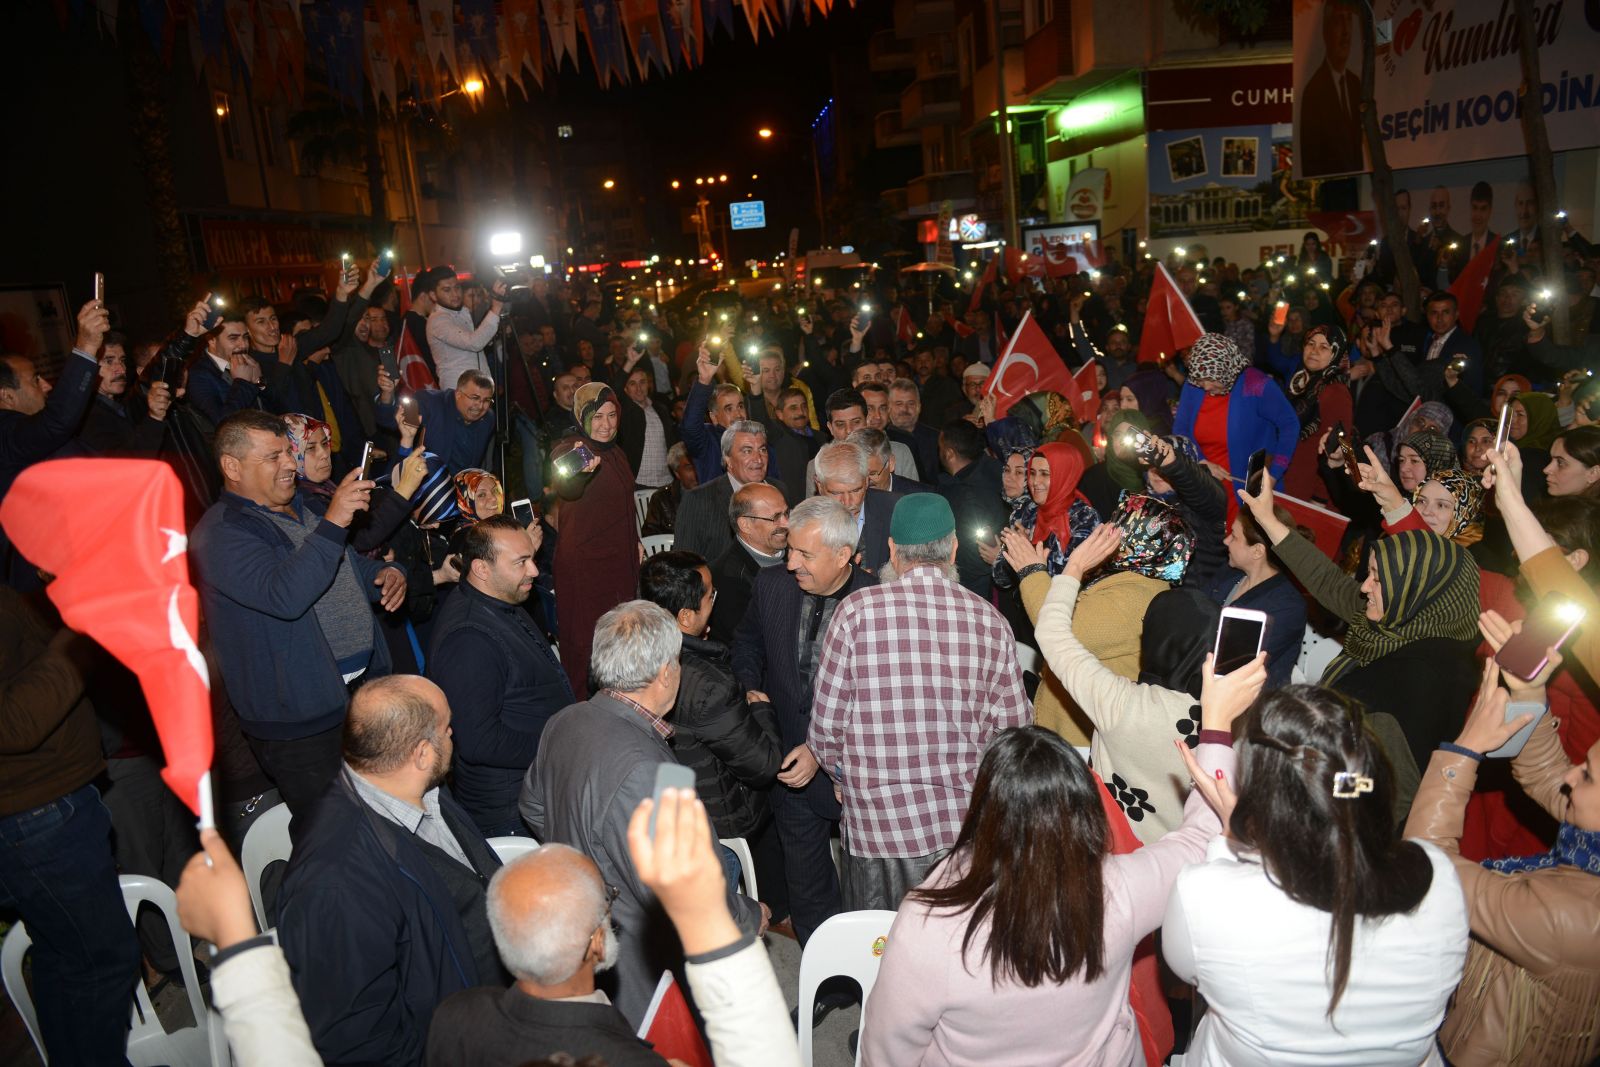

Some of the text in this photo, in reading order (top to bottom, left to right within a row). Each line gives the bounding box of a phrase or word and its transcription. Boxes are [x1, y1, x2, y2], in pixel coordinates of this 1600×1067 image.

[1423, 0, 1564, 75] Kumlua
[1231, 88, 1294, 107] CUMH
[1381, 70, 1600, 141] SEÇİM KOODİN
